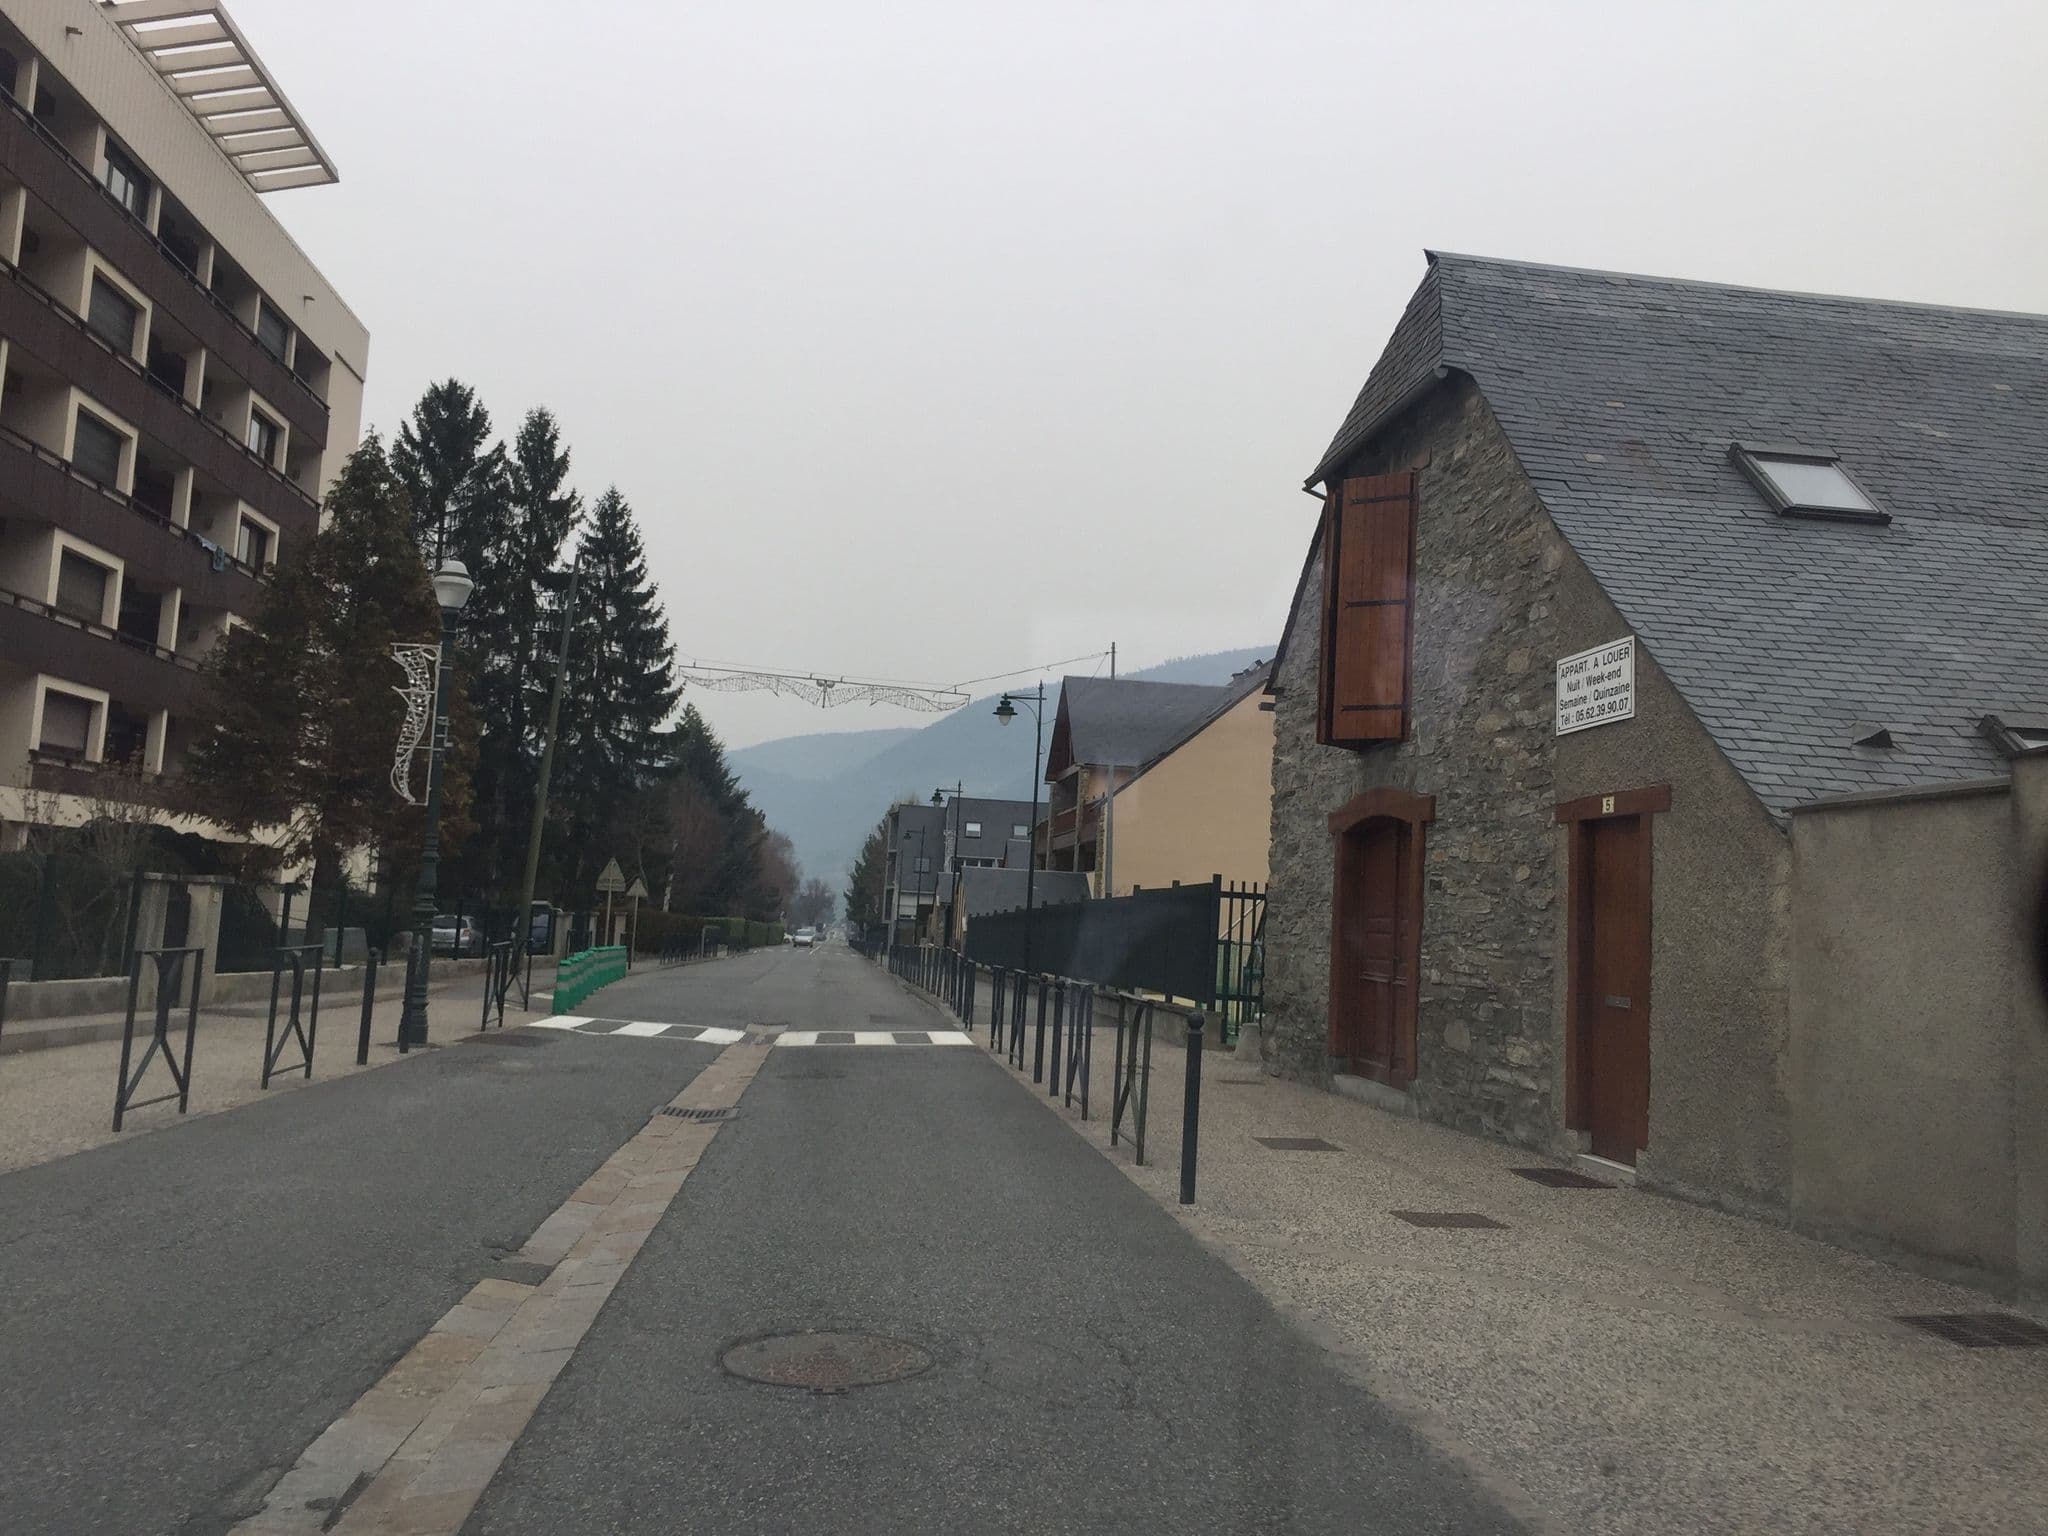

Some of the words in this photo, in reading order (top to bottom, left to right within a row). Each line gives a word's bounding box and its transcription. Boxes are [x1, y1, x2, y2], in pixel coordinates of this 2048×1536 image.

[1560, 660, 1590, 679] APPART.
[1602, 647, 1630, 666] LOUER
[1566, 679, 1580, 693] Nuit
[1585, 666, 1622, 686] Week-end
[1559, 694, 1588, 711] Semaine
[1593, 682, 1630, 701] Quinzaine
[1605, 799, 1611, 812] 5
